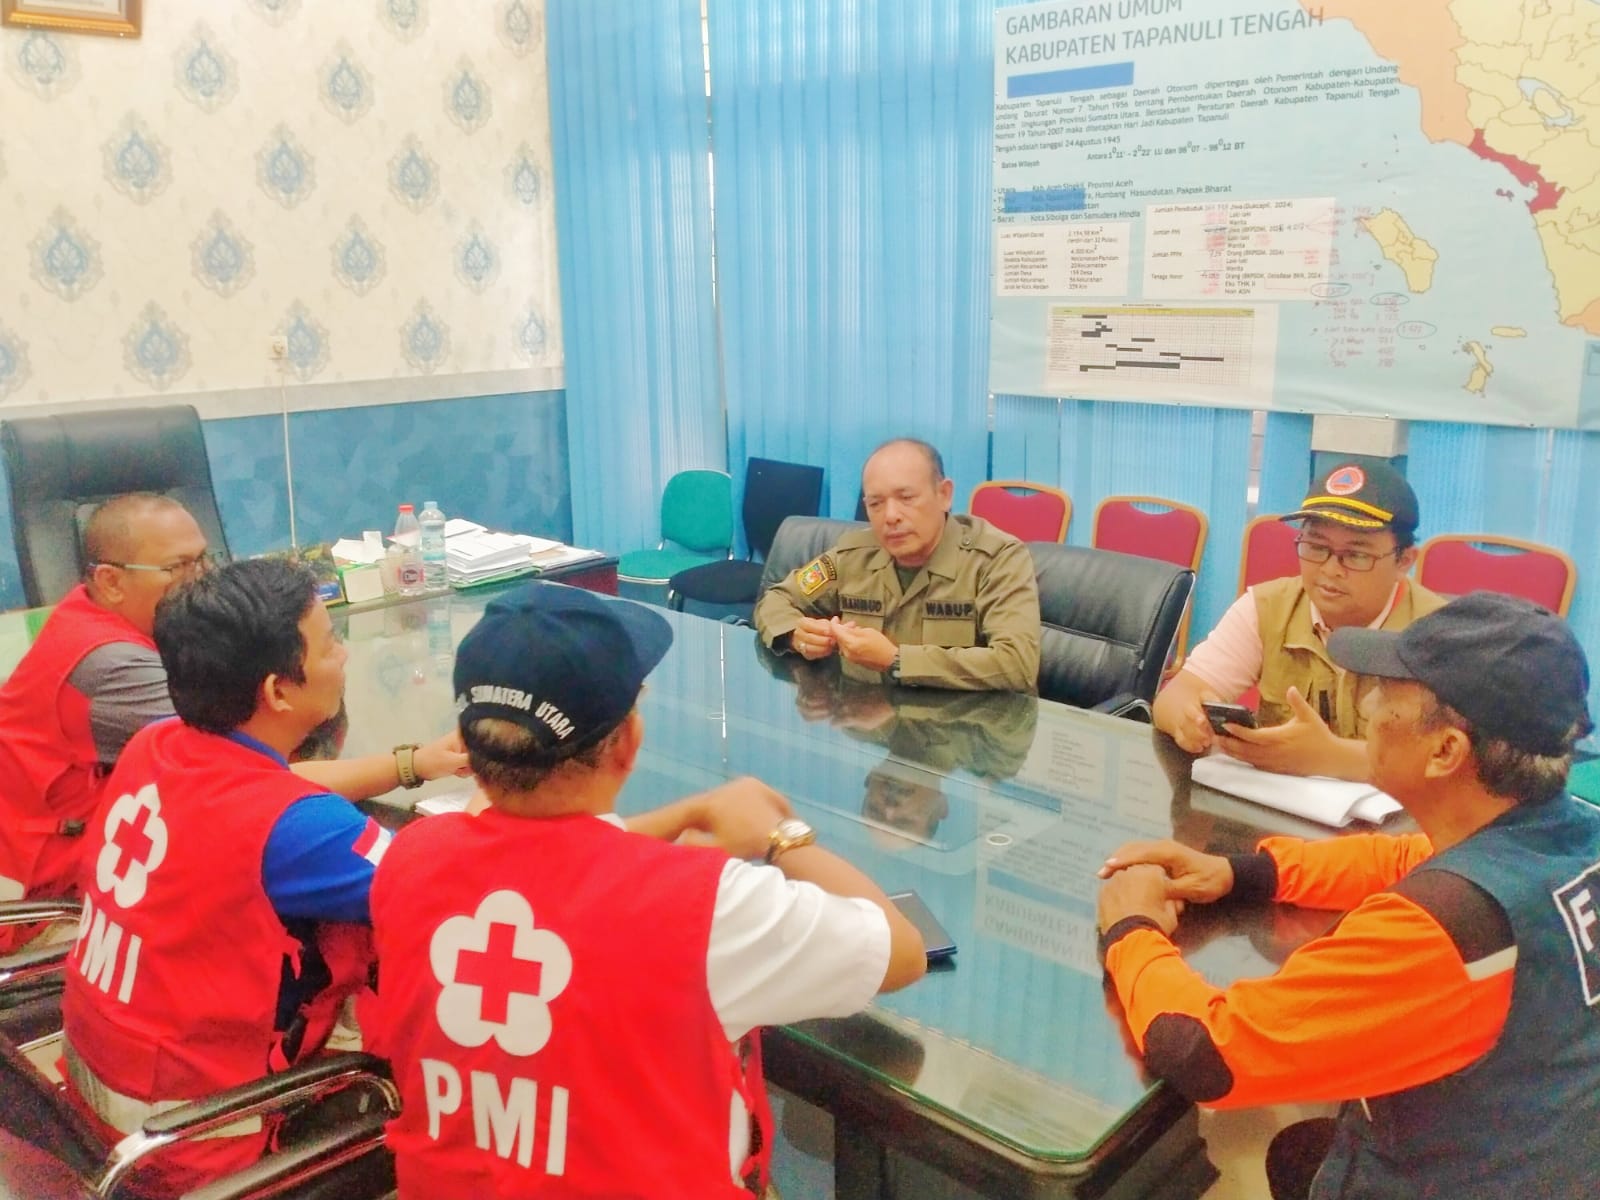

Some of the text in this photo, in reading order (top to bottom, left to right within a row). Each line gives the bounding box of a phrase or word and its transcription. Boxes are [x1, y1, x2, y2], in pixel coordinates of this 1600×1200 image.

[1006, 0, 1182, 35] GAMBARAN UMUM
[1006, 6, 1324, 65] KABUPATEN TAPANULI TENGAH
[996, 101, 1031, 111] Kabupaten
[1070, 95, 1095, 104] Tengah
[1100, 91, 1128, 100] sebagai
[1133, 87, 1160, 97] Daerah
[1166, 84, 1198, 94] Otonom
[1204, 79, 1249, 91] dipertegas
[1254, 75, 1273, 85] oleh
[1276, 70, 1323, 83] Pemerintah
[1329, 67, 1363, 79] dengan
[1088, 103, 1109, 112] Tahun
[1134, 99, 1164, 108] tentang
[1168, 93, 1223, 104] Pembentukan
[1226, 89, 1256, 98] Daerah
[1263, 85, 1298, 95] Otonom
[1088, 113, 1118, 122] Sumatra
[1197, 102, 1235, 112] Peraturan
[1240, 98, 1269, 108] Daerah
[1274, 94, 1318, 107] Kabupaten
[1325, 91, 1363, 102] Tapanuli
[1368, 88, 1400, 99] Tengah
[1124, 119, 1140, 128] Hari
[1156, 115, 1194, 127] Kabupaten
[1198, 113, 1230, 124] Tapanuli
[1065, 139, 1074, 148] 24
[1075, 138, 1102, 148] Agustus
[1103, 136, 1120, 144] 1945
[1115, 179, 1134, 187] Aceh
[1205, 184, 1232, 194] Bharat
[926, 602, 972, 617] WABUP
[470, 685, 533, 711] SUMATERA
[535, 701, 575, 739] UTARA
[74, 892, 142, 1004] PMI
[419, 1057, 570, 1177] PMI
